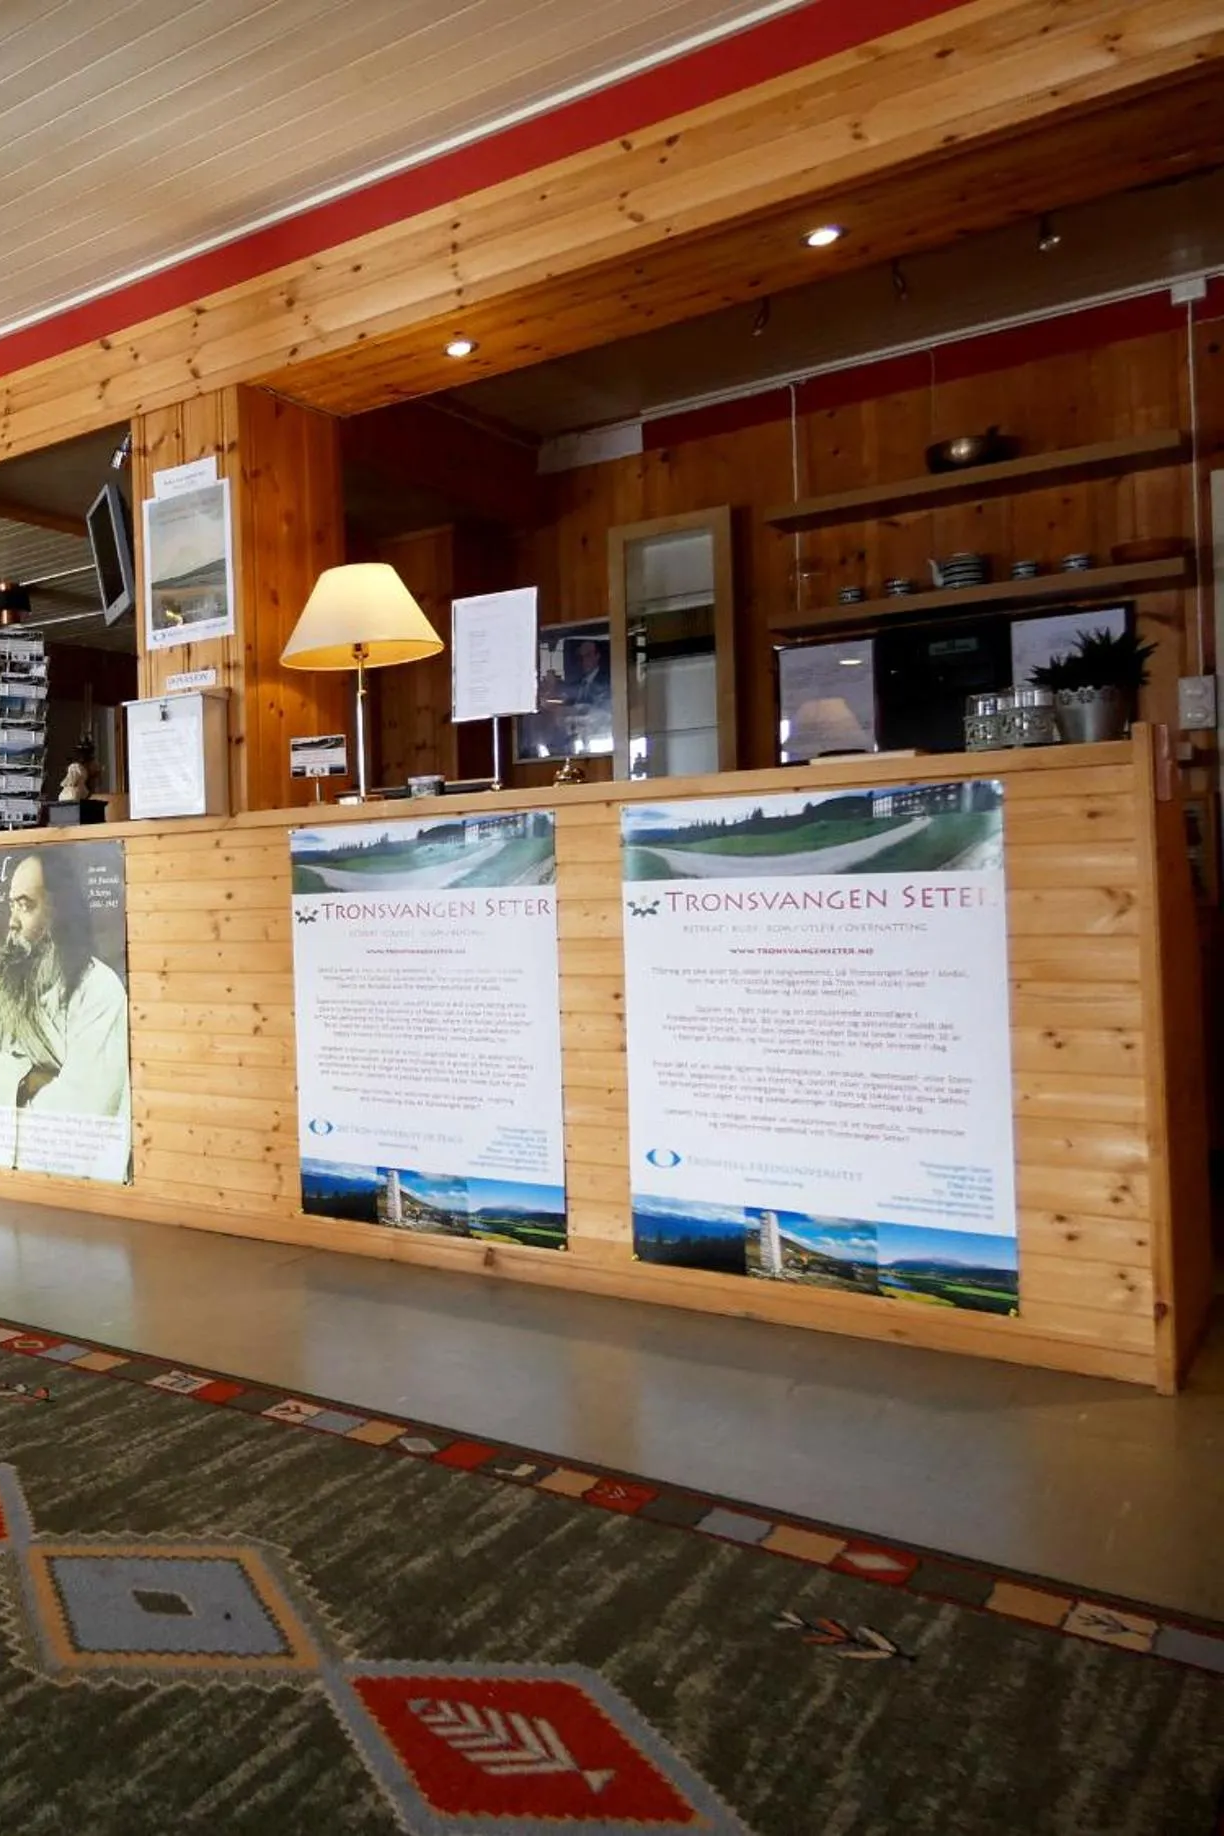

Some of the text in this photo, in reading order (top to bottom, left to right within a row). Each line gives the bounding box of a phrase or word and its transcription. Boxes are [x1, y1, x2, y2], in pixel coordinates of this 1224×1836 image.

[321, 898, 551, 921] TRONSVANGEN SETER
[664, 888, 888, 913] TRONSVANGEN
